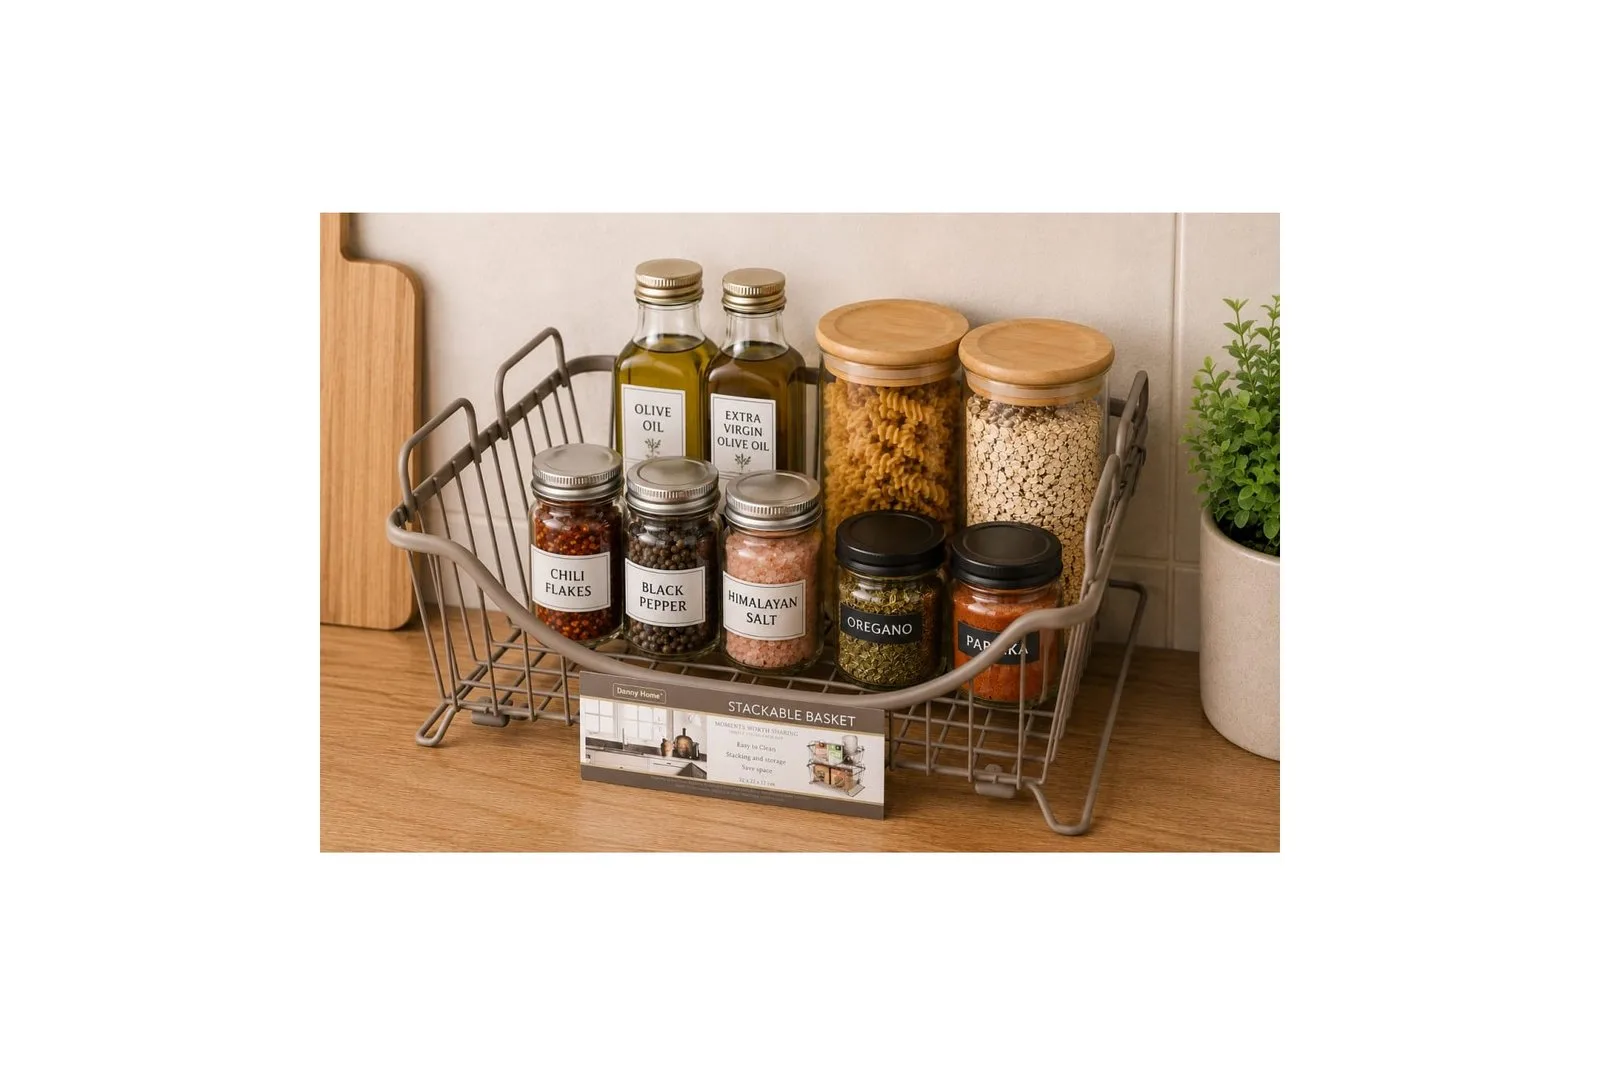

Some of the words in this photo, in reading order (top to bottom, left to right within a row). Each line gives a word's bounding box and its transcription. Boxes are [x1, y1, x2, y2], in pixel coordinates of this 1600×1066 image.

[634, 404, 672, 418] OLIVE
[725, 411, 761, 424] EXTRA
[642, 420, 664, 432] OIL
[724, 424, 763, 436] VIRGIN
[717, 436, 748, 450] OLIVE
[752, 440, 770, 452] OIL
[550, 568, 585, 582] CHILI
[545, 582, 592, 597] FLAKES
[642, 582, 684, 596] BLACK
[639, 596, 687, 612] PEPPER
[728, 590, 798, 609] HIMALAYAN
[746, 612, 778, 626] SALT
[847, 616, 912, 636] OREGANO
[966, 634, 1028, 655] PAPKA
[616, 687, 638, 697] Danny
[728, 700, 802, 720] STACKABLE
[806, 711, 856, 726] BASKET
[736, 742, 750, 750] Easy
[726, 752, 751, 762] Stacking
[764, 758, 786, 766] storage
